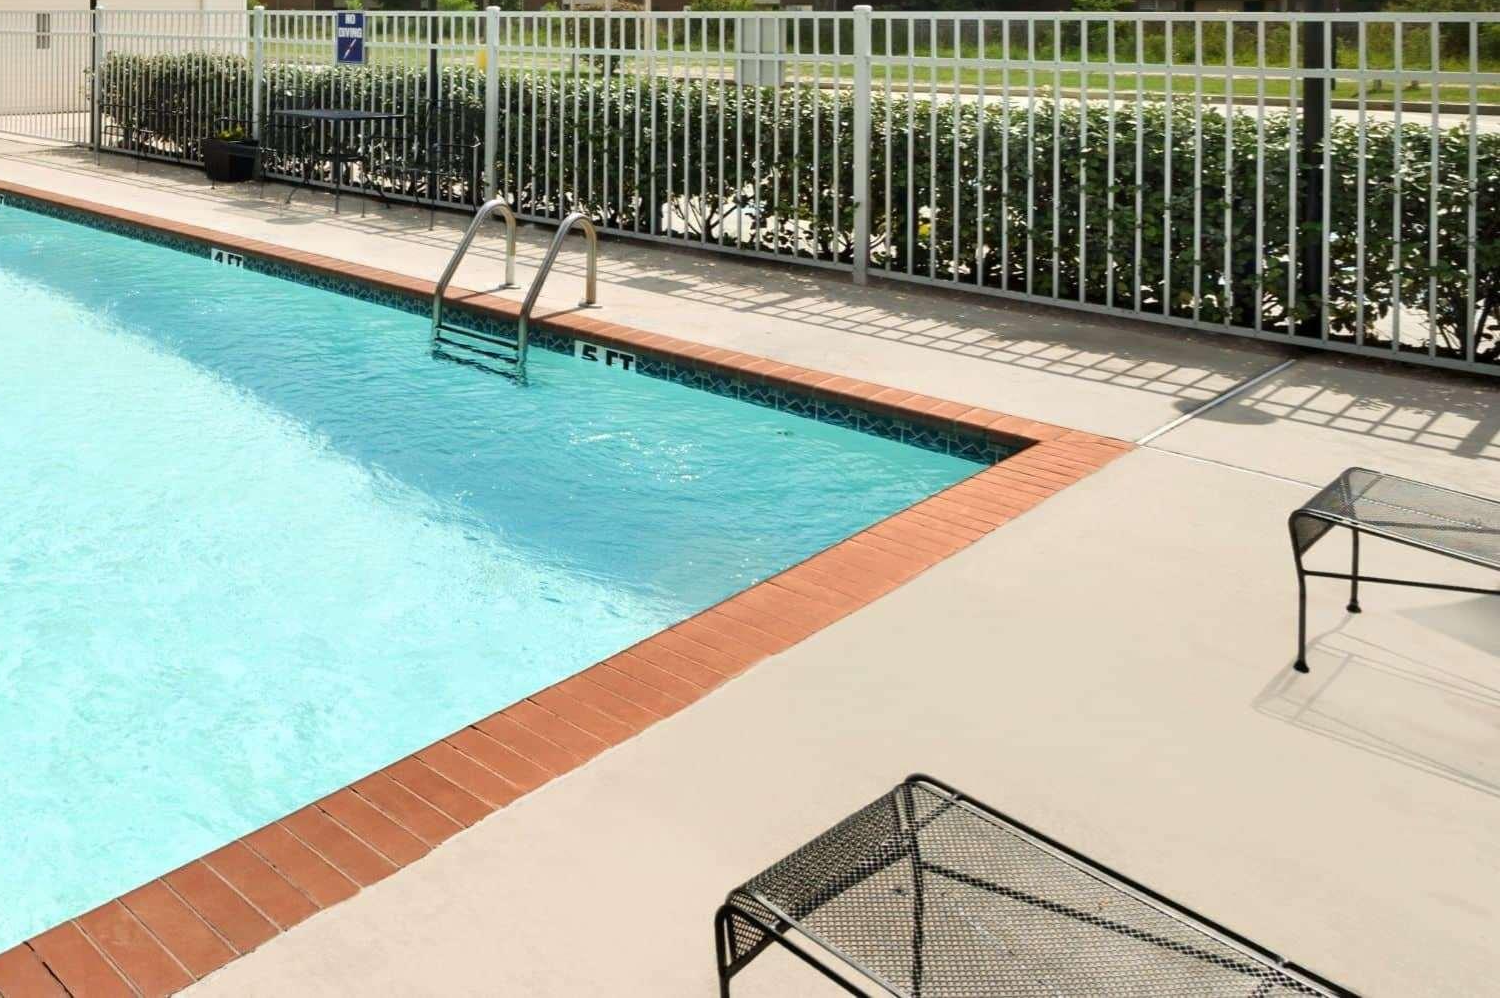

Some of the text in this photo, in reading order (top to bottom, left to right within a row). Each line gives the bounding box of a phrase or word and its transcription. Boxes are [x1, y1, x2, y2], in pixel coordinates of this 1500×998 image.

[345, 13, 356, 24] NO
[338, 27, 363, 38] DIVING
[213, 251, 243, 267] 4 FT
[580, 343, 634, 371] 5 FT
